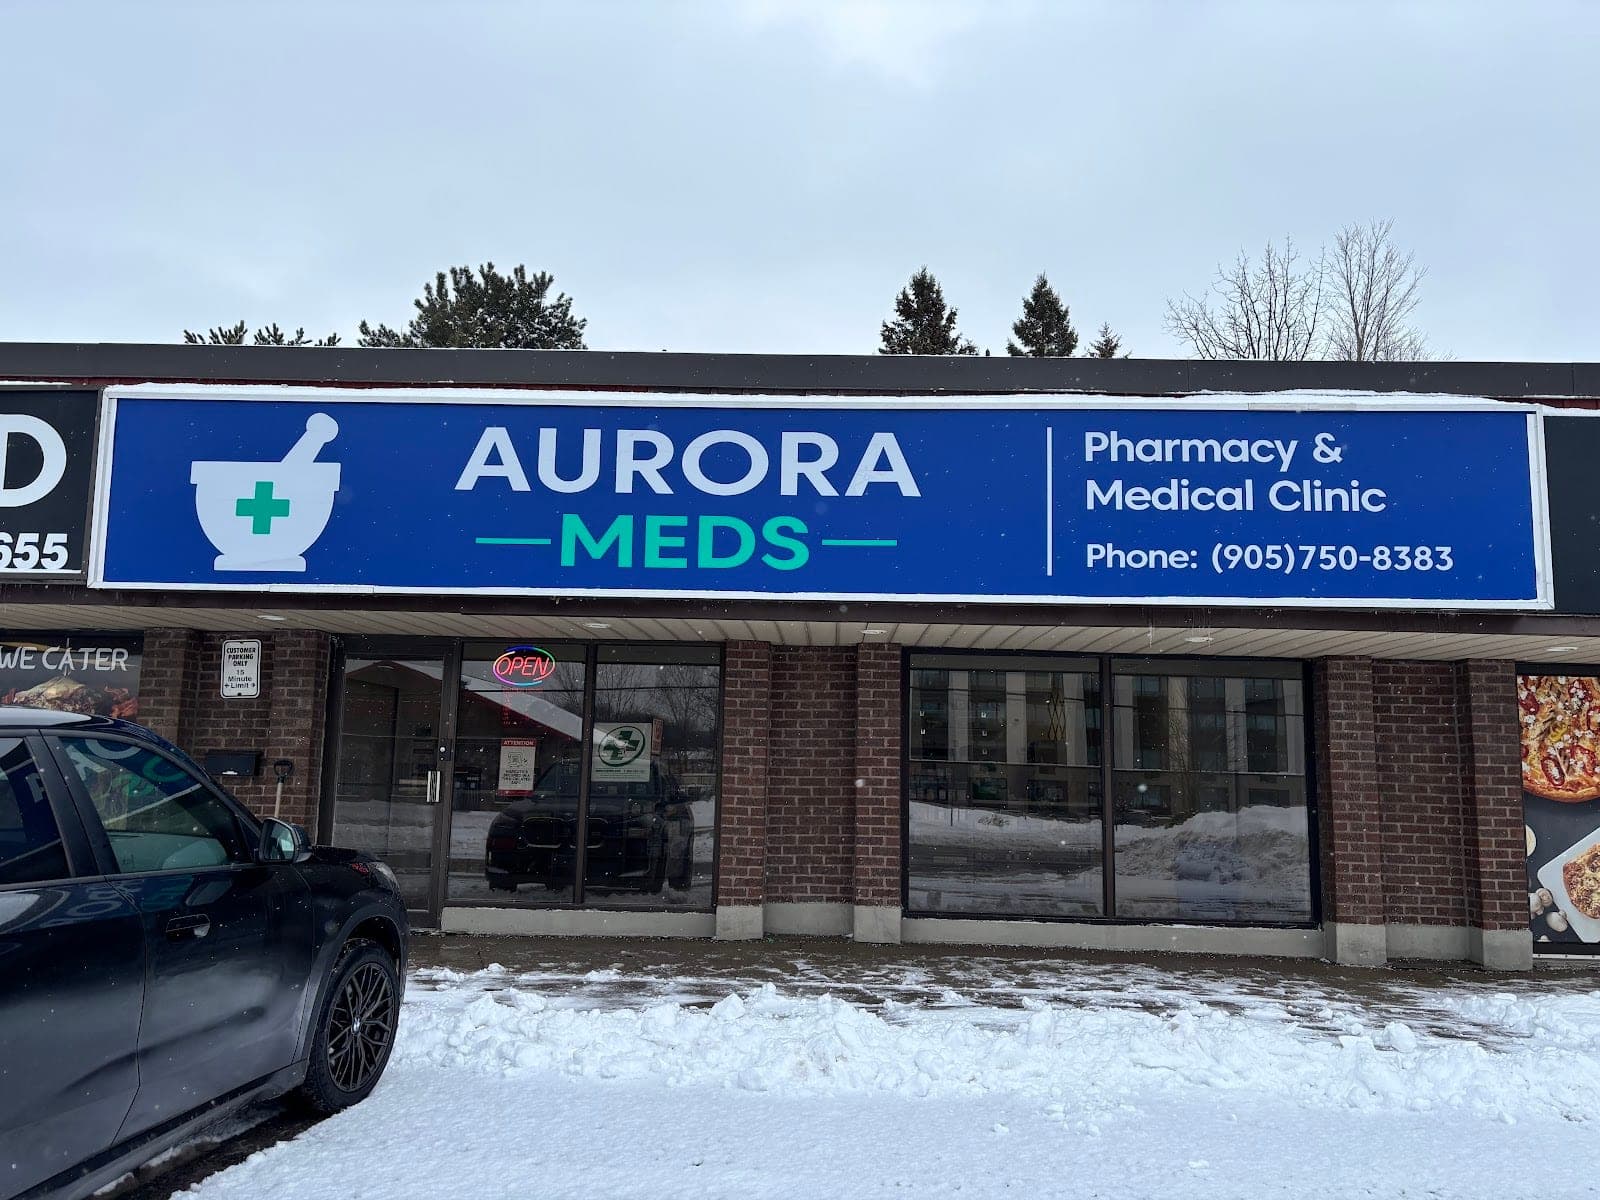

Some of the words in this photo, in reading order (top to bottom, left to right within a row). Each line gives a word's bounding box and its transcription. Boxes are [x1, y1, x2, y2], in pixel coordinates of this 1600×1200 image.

[454, 426, 921, 498] AURORA
[1084, 430, 1298, 472] Pharmacy
[1312, 432, 1343, 464] &
[1086, 478, 1254, 512] Medical
[1268, 480, 1387, 513] Clinic
[560, 513, 809, 570] MEDS
[1086, 543, 1198, 569] Phone:
[0, 646, 37, 670] WE
[42, 646, 129, 672] CATER
[496, 656, 550, 676] OPEN
